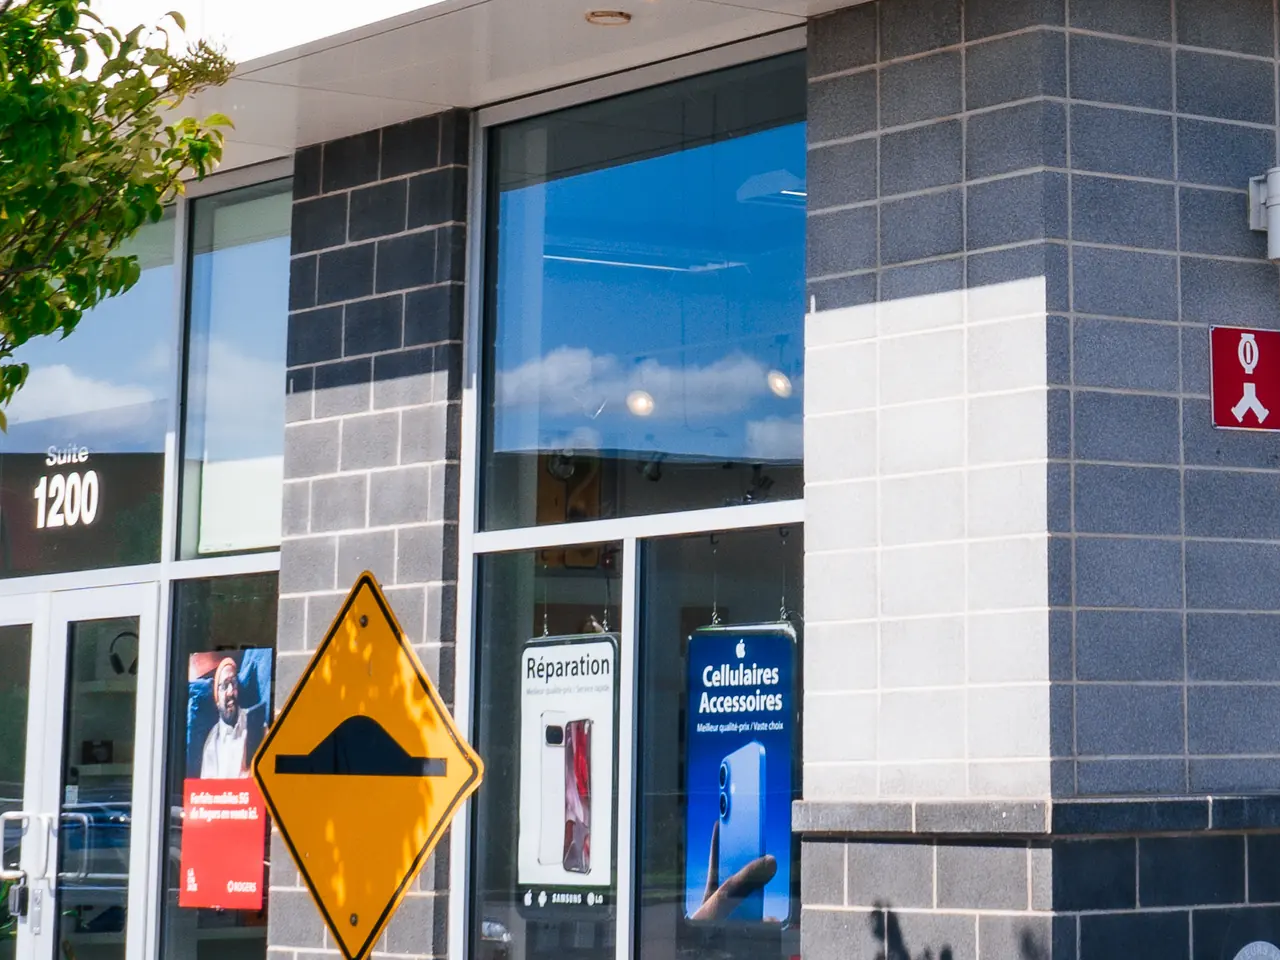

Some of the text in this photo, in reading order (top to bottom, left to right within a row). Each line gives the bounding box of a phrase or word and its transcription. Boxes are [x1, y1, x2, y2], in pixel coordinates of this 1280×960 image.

[45, 443, 89, 467] Suite
[34, 470, 99, 529] 1200
[526, 653, 610, 685] Réparation
[702, 663, 779, 688] Cellulaires
[699, 689, 783, 714] Accessoires
[552, 893, 581, 903] SAMSUNG
